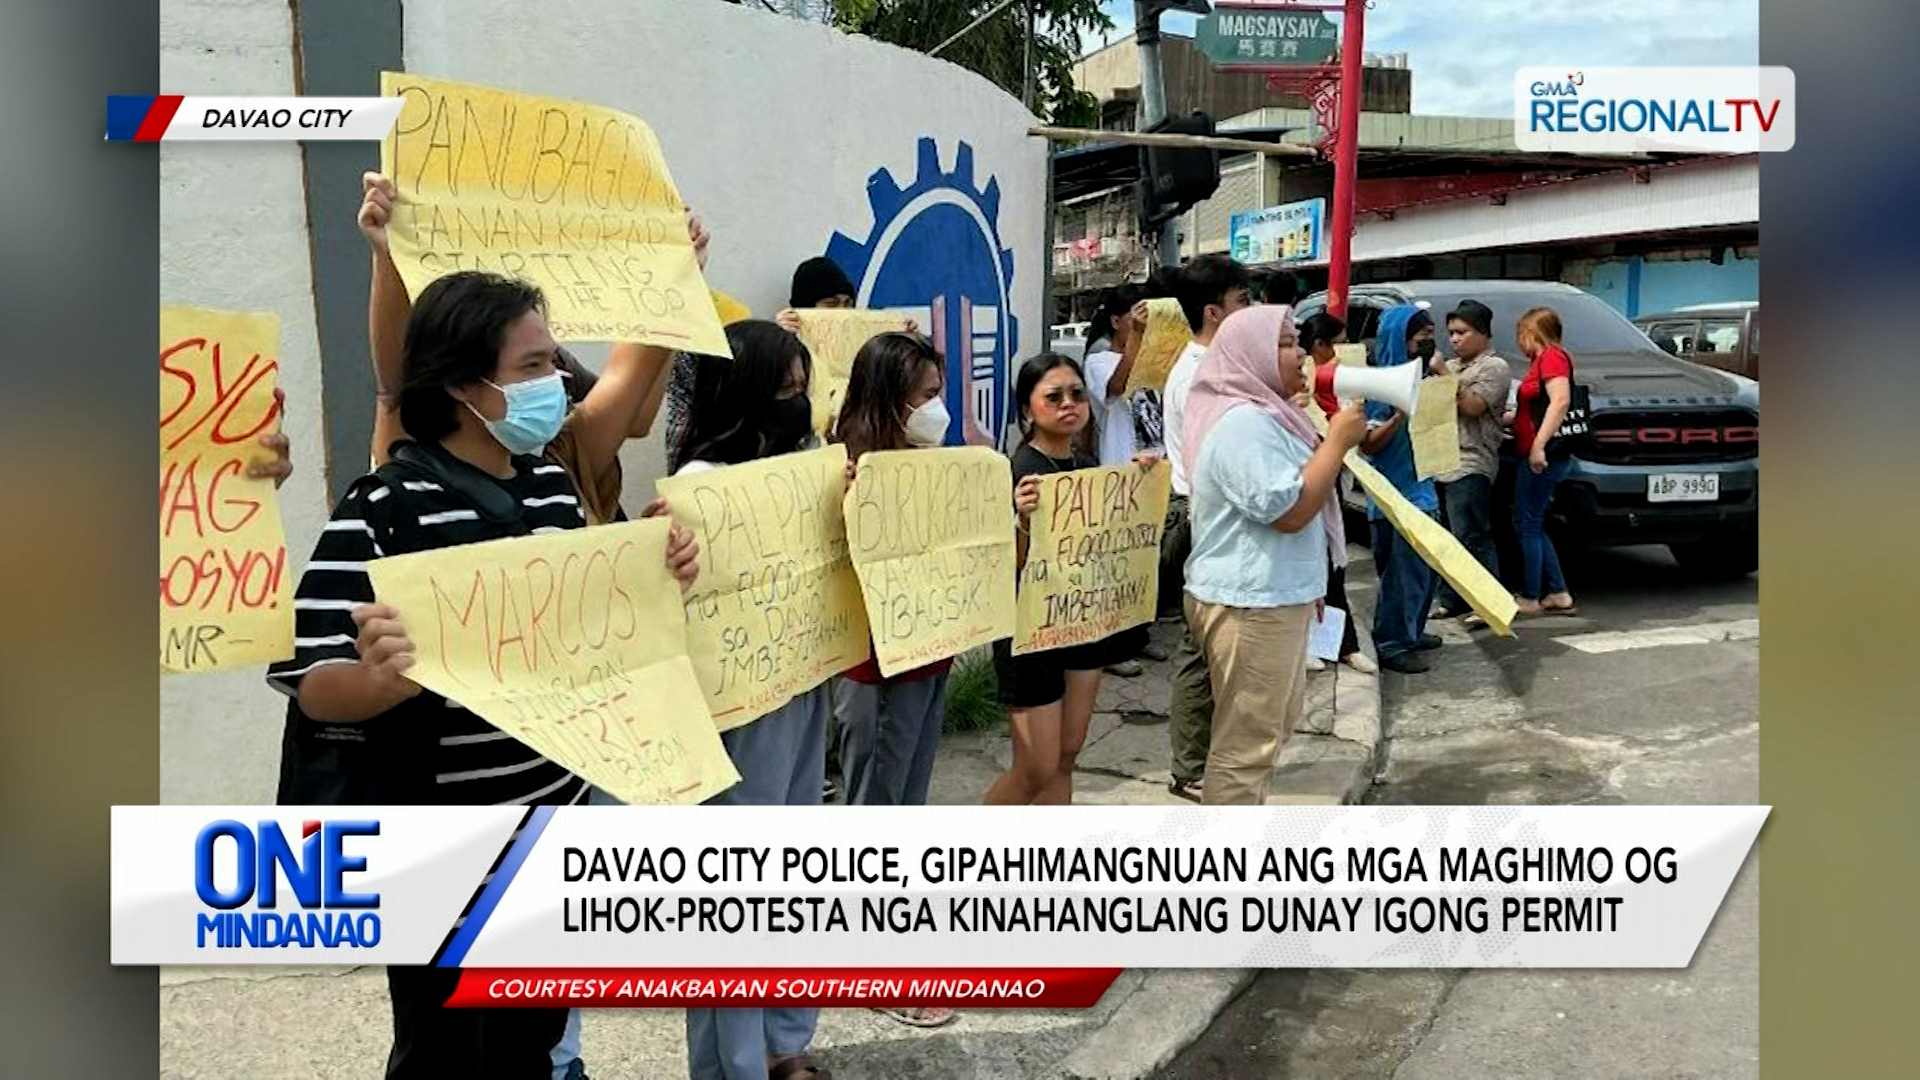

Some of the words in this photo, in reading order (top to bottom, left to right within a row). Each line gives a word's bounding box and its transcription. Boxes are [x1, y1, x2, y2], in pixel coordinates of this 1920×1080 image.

[1218, 15, 1320, 38] MAGSAYSAY
[412, 202, 544, 249] TANAN
[160, 454, 260, 538] AG
[1051, 471, 1147, 532] PALPAK
[160, 546, 286, 613] OSYO!
[430, 541, 637, 688] MARCOS
[722, 627, 749, 653] sa
